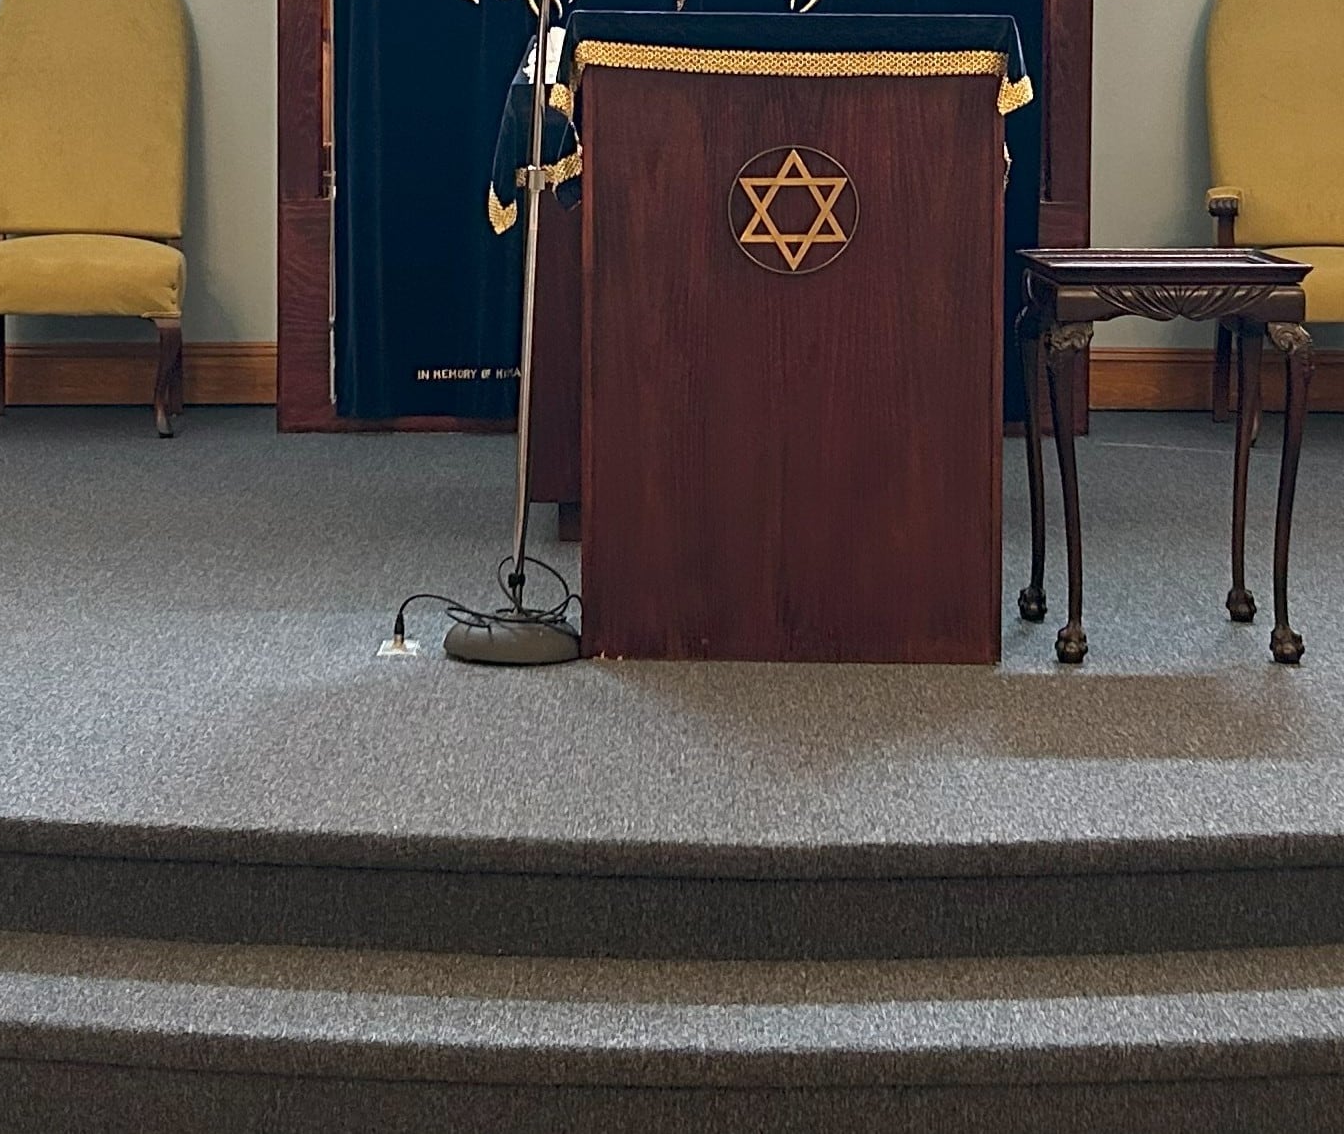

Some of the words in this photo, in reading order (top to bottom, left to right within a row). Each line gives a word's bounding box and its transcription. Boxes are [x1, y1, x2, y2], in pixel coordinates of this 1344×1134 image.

[417, 369, 430, 381] IN
[433, 369, 478, 380] MEMORY
[480, 369, 491, 379] OF
